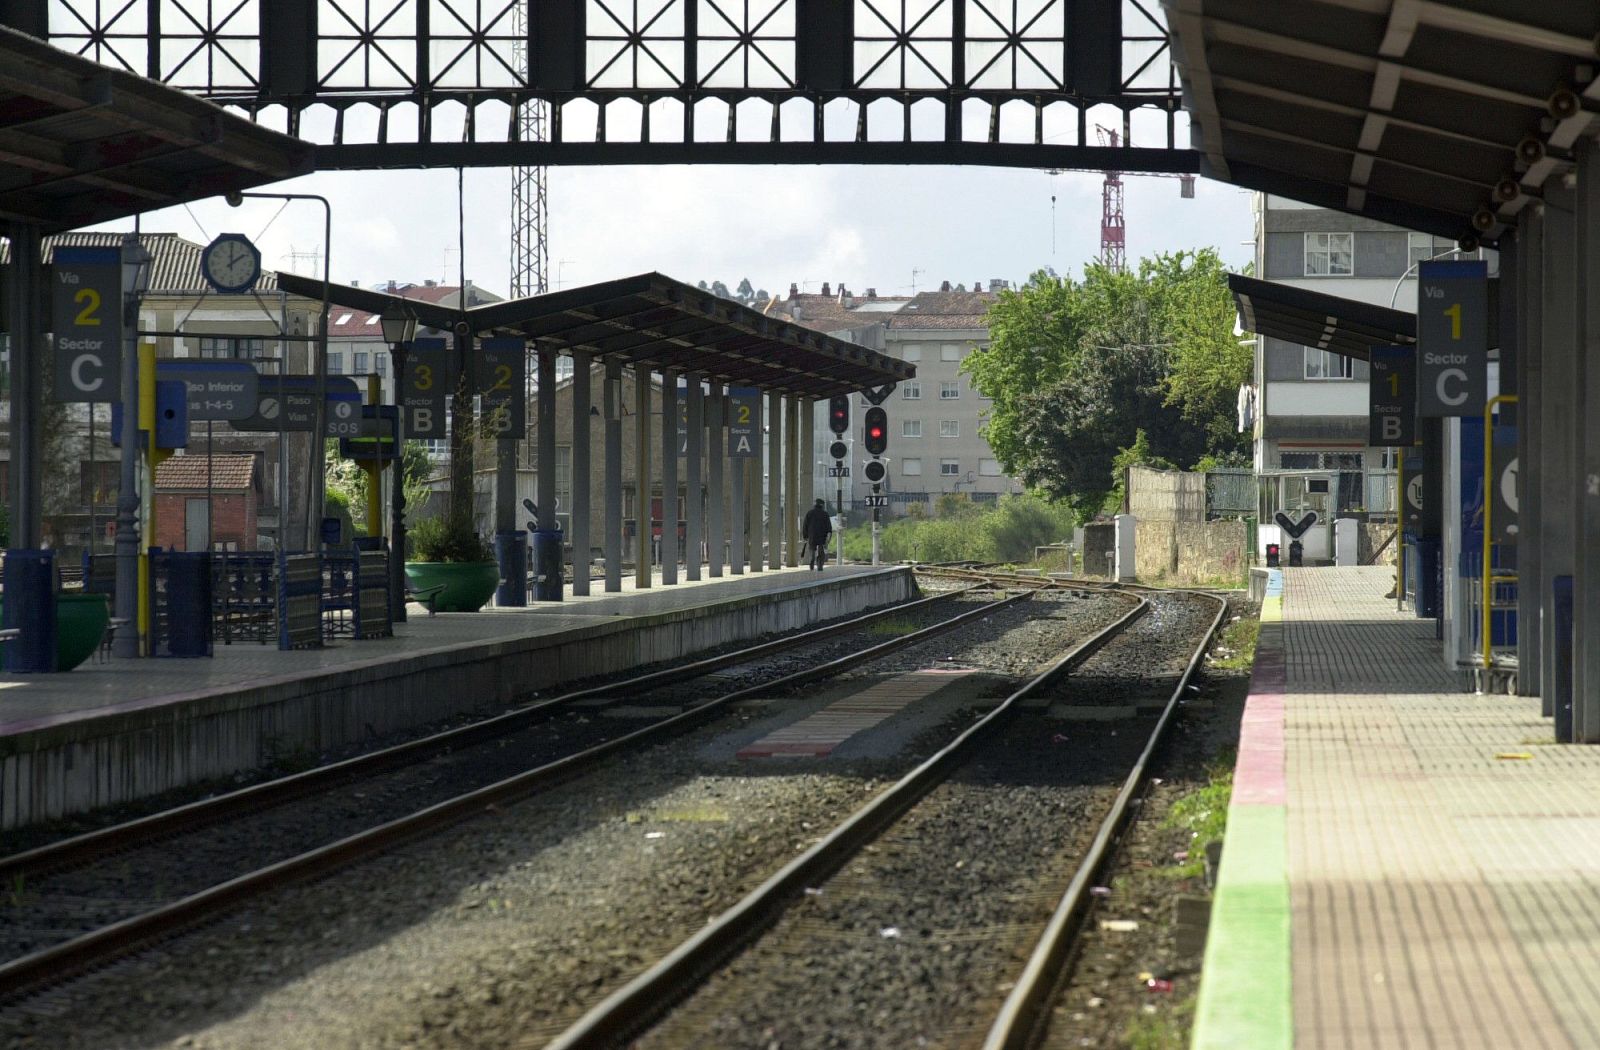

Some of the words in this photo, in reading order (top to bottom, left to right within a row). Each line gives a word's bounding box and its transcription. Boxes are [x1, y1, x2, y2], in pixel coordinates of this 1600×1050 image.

[74, 288, 102, 326] 2
[1443, 303, 1462, 341] 1
[58, 337, 103, 350] Sector
[1424, 352, 1469, 365] Sector
[71, 353, 104, 392] C
[415, 363, 433, 391] 3
[495, 363, 513, 391] 2
[1386, 372, 1399, 397] 1
[207, 381, 245, 392] Inferior
[1435, 368, 1469, 406] C
[204, 400, 234, 410] 1-4-5
[404, 397, 433, 406] Sector
[1374, 404, 1402, 413] Sector
[413, 408, 433, 432] B
[492, 408, 513, 432] B
[737, 404, 751, 425] 2
[327, 422, 359, 434] SOS
[1382, 416, 1402, 440] B
[736, 435, 751, 453] A
